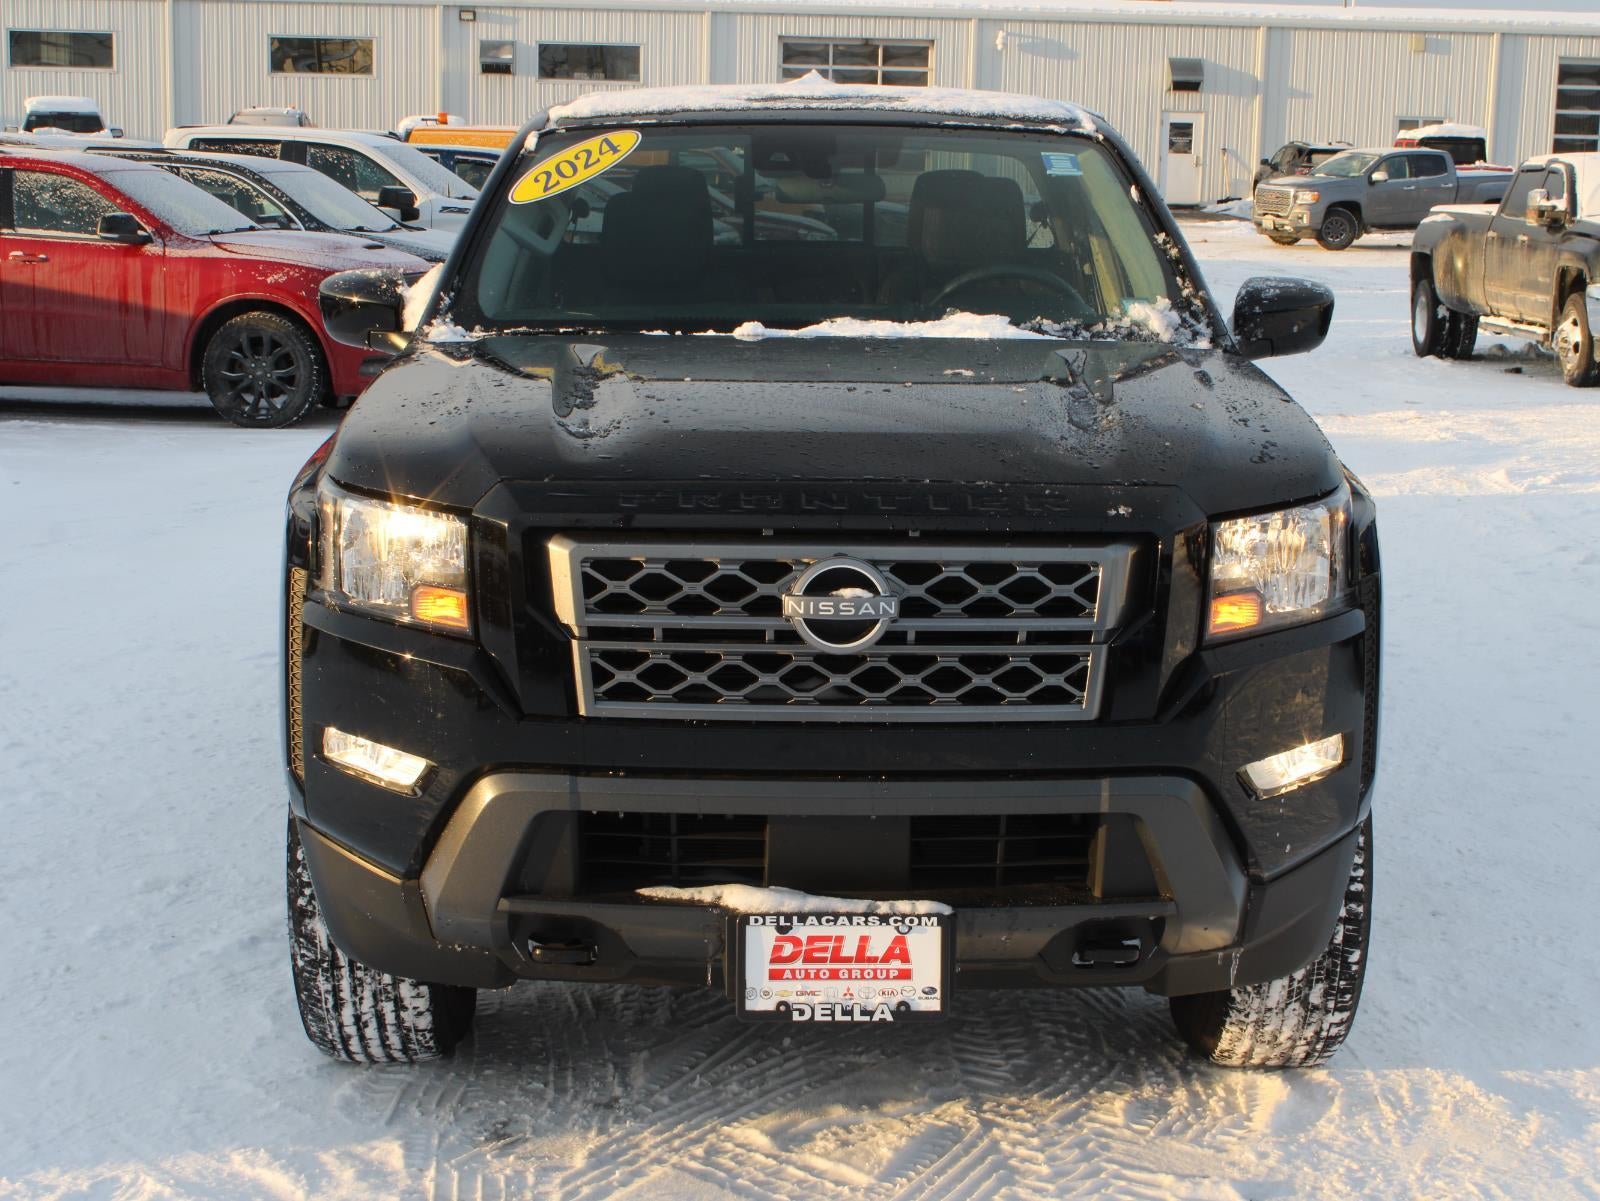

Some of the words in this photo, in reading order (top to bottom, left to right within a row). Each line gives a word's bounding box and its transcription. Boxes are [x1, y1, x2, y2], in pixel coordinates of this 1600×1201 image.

[533, 137, 621, 193] 2024
[788, 601, 896, 616] NISSAN
[749, 915, 938, 927] DELLACARS.COM
[769, 935, 912, 965] DELLA
[783, 969, 830, 979] AUTO
[838, 969, 899, 979] GROUP
[881, 989, 896, 997] KIA
[792, 1003, 894, 1022] DELLA
